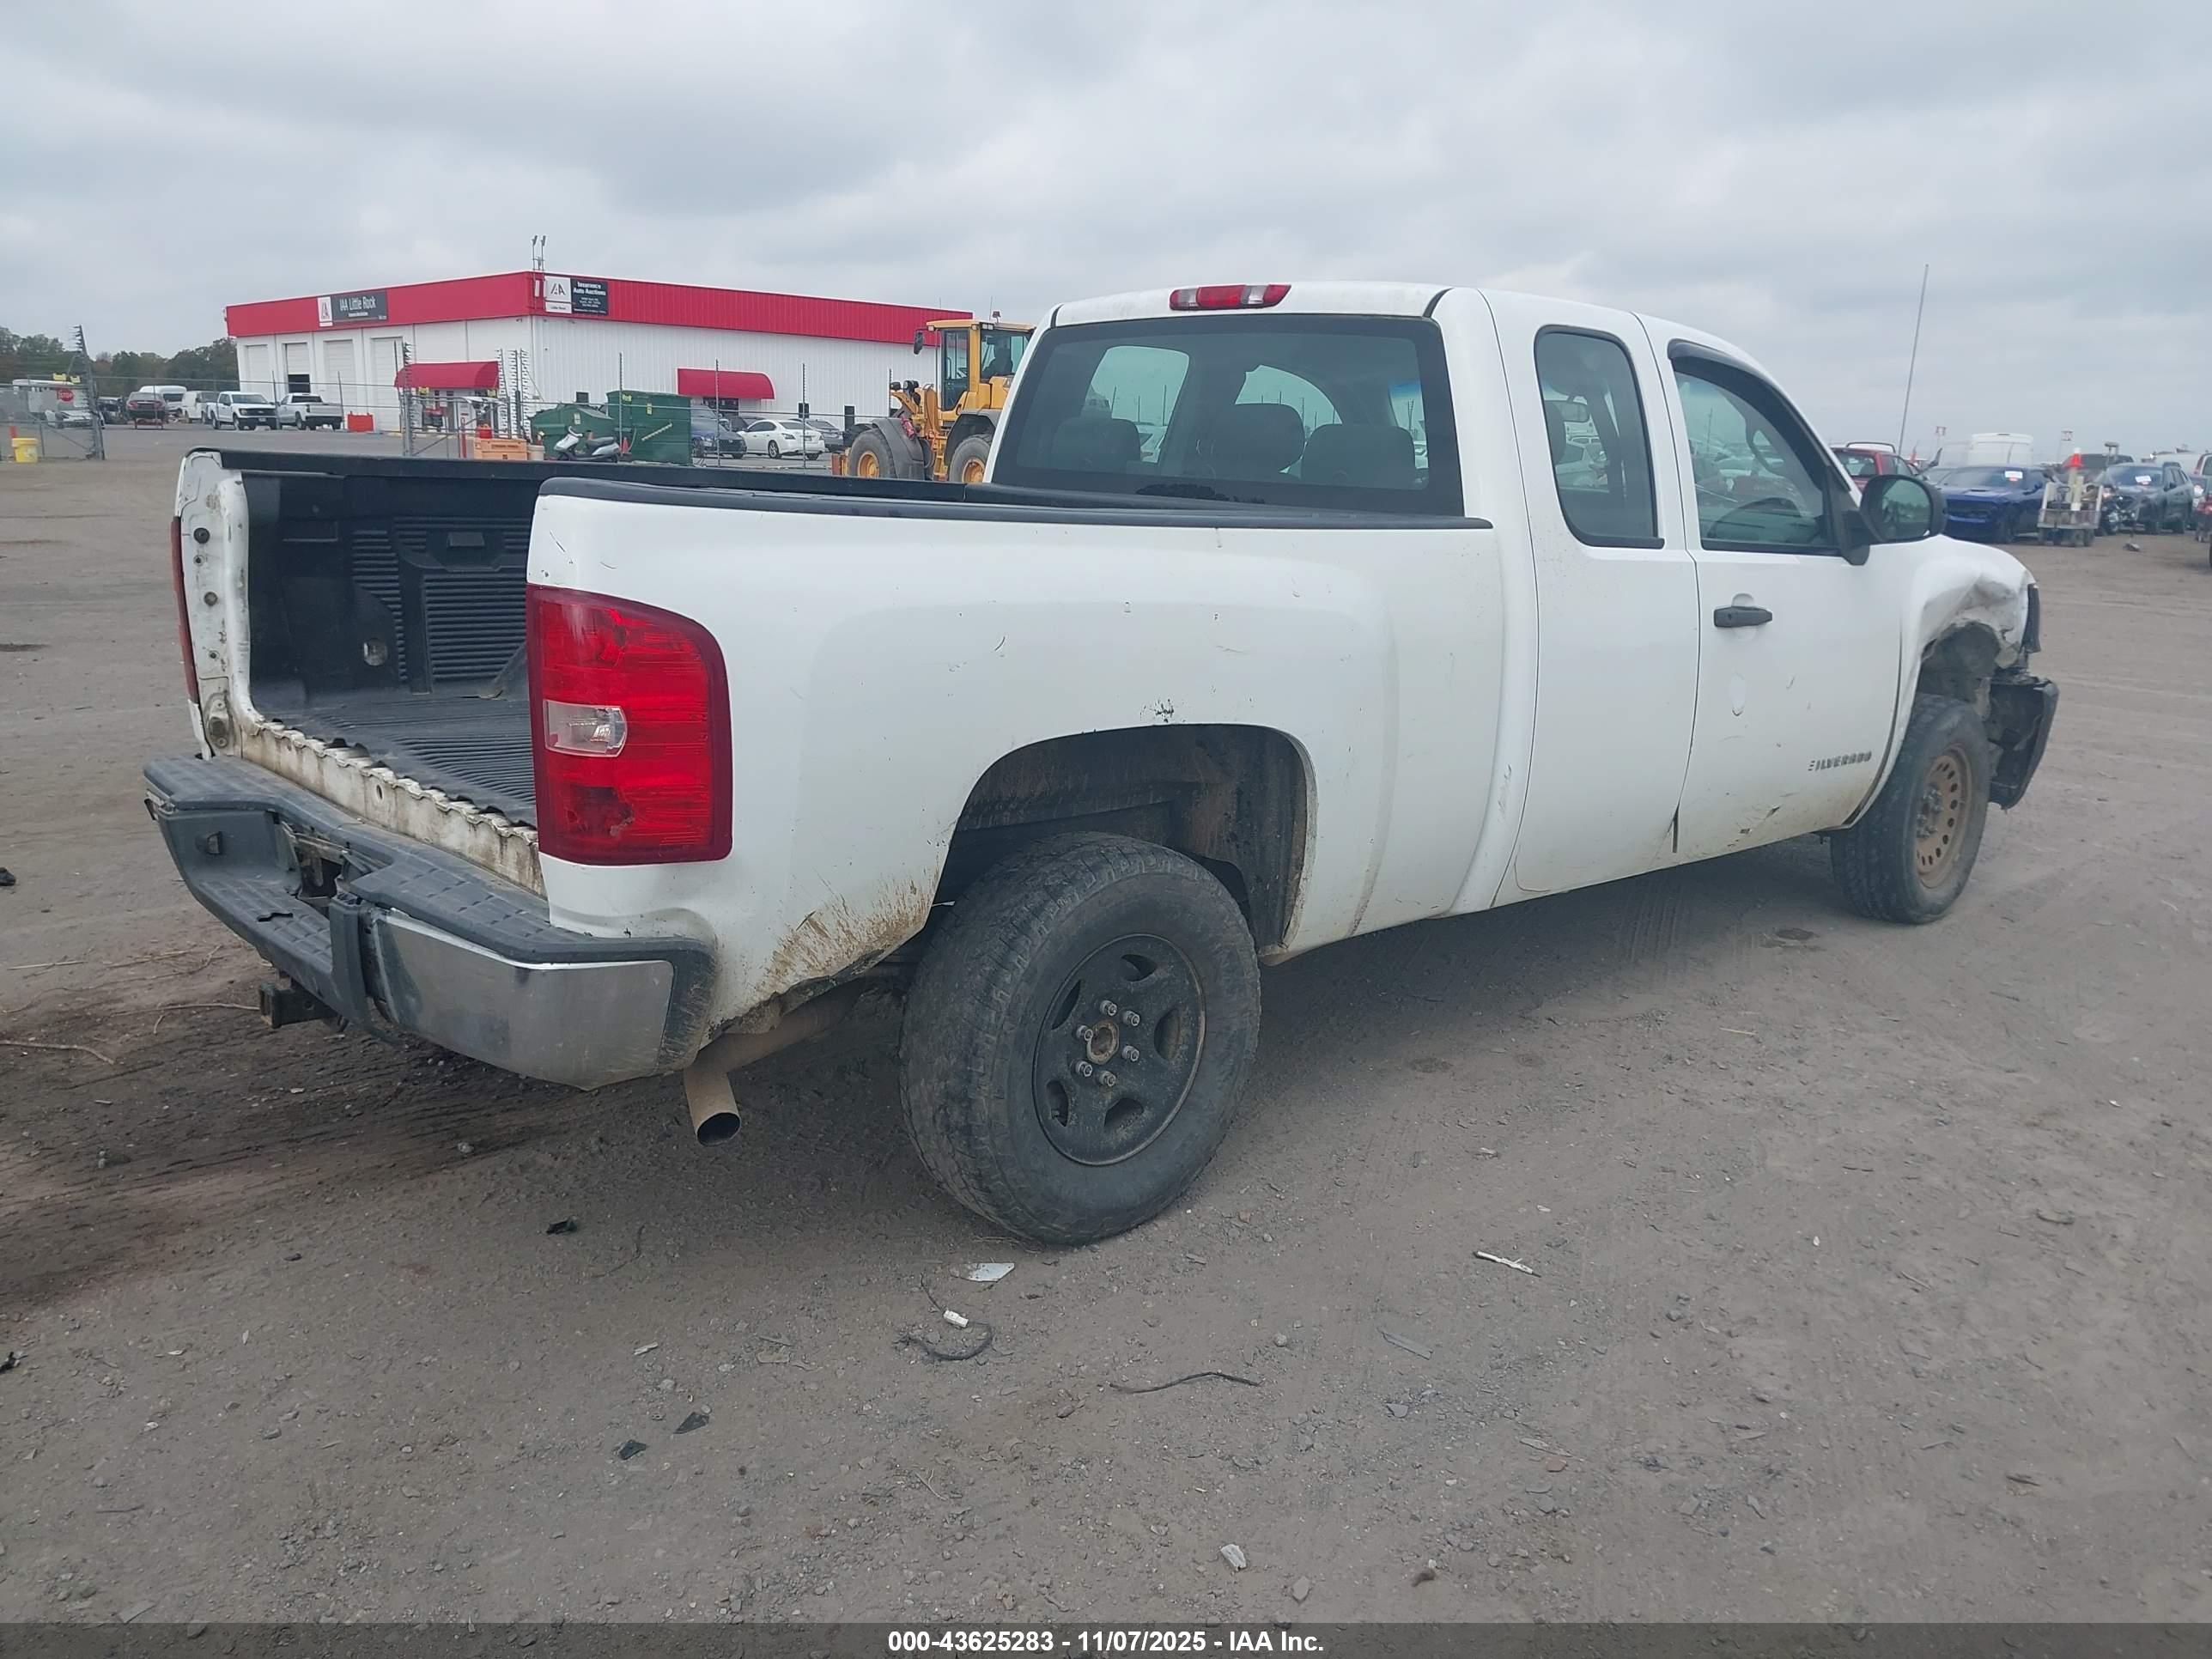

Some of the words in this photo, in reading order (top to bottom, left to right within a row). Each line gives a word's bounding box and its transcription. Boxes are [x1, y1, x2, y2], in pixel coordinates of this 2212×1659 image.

[585, 288, 606, 296] Auctions
[349, 297, 362, 310] Little
[362, 295, 376, 309] Rock
[1808, 751, 1872, 771] SILVERADO
